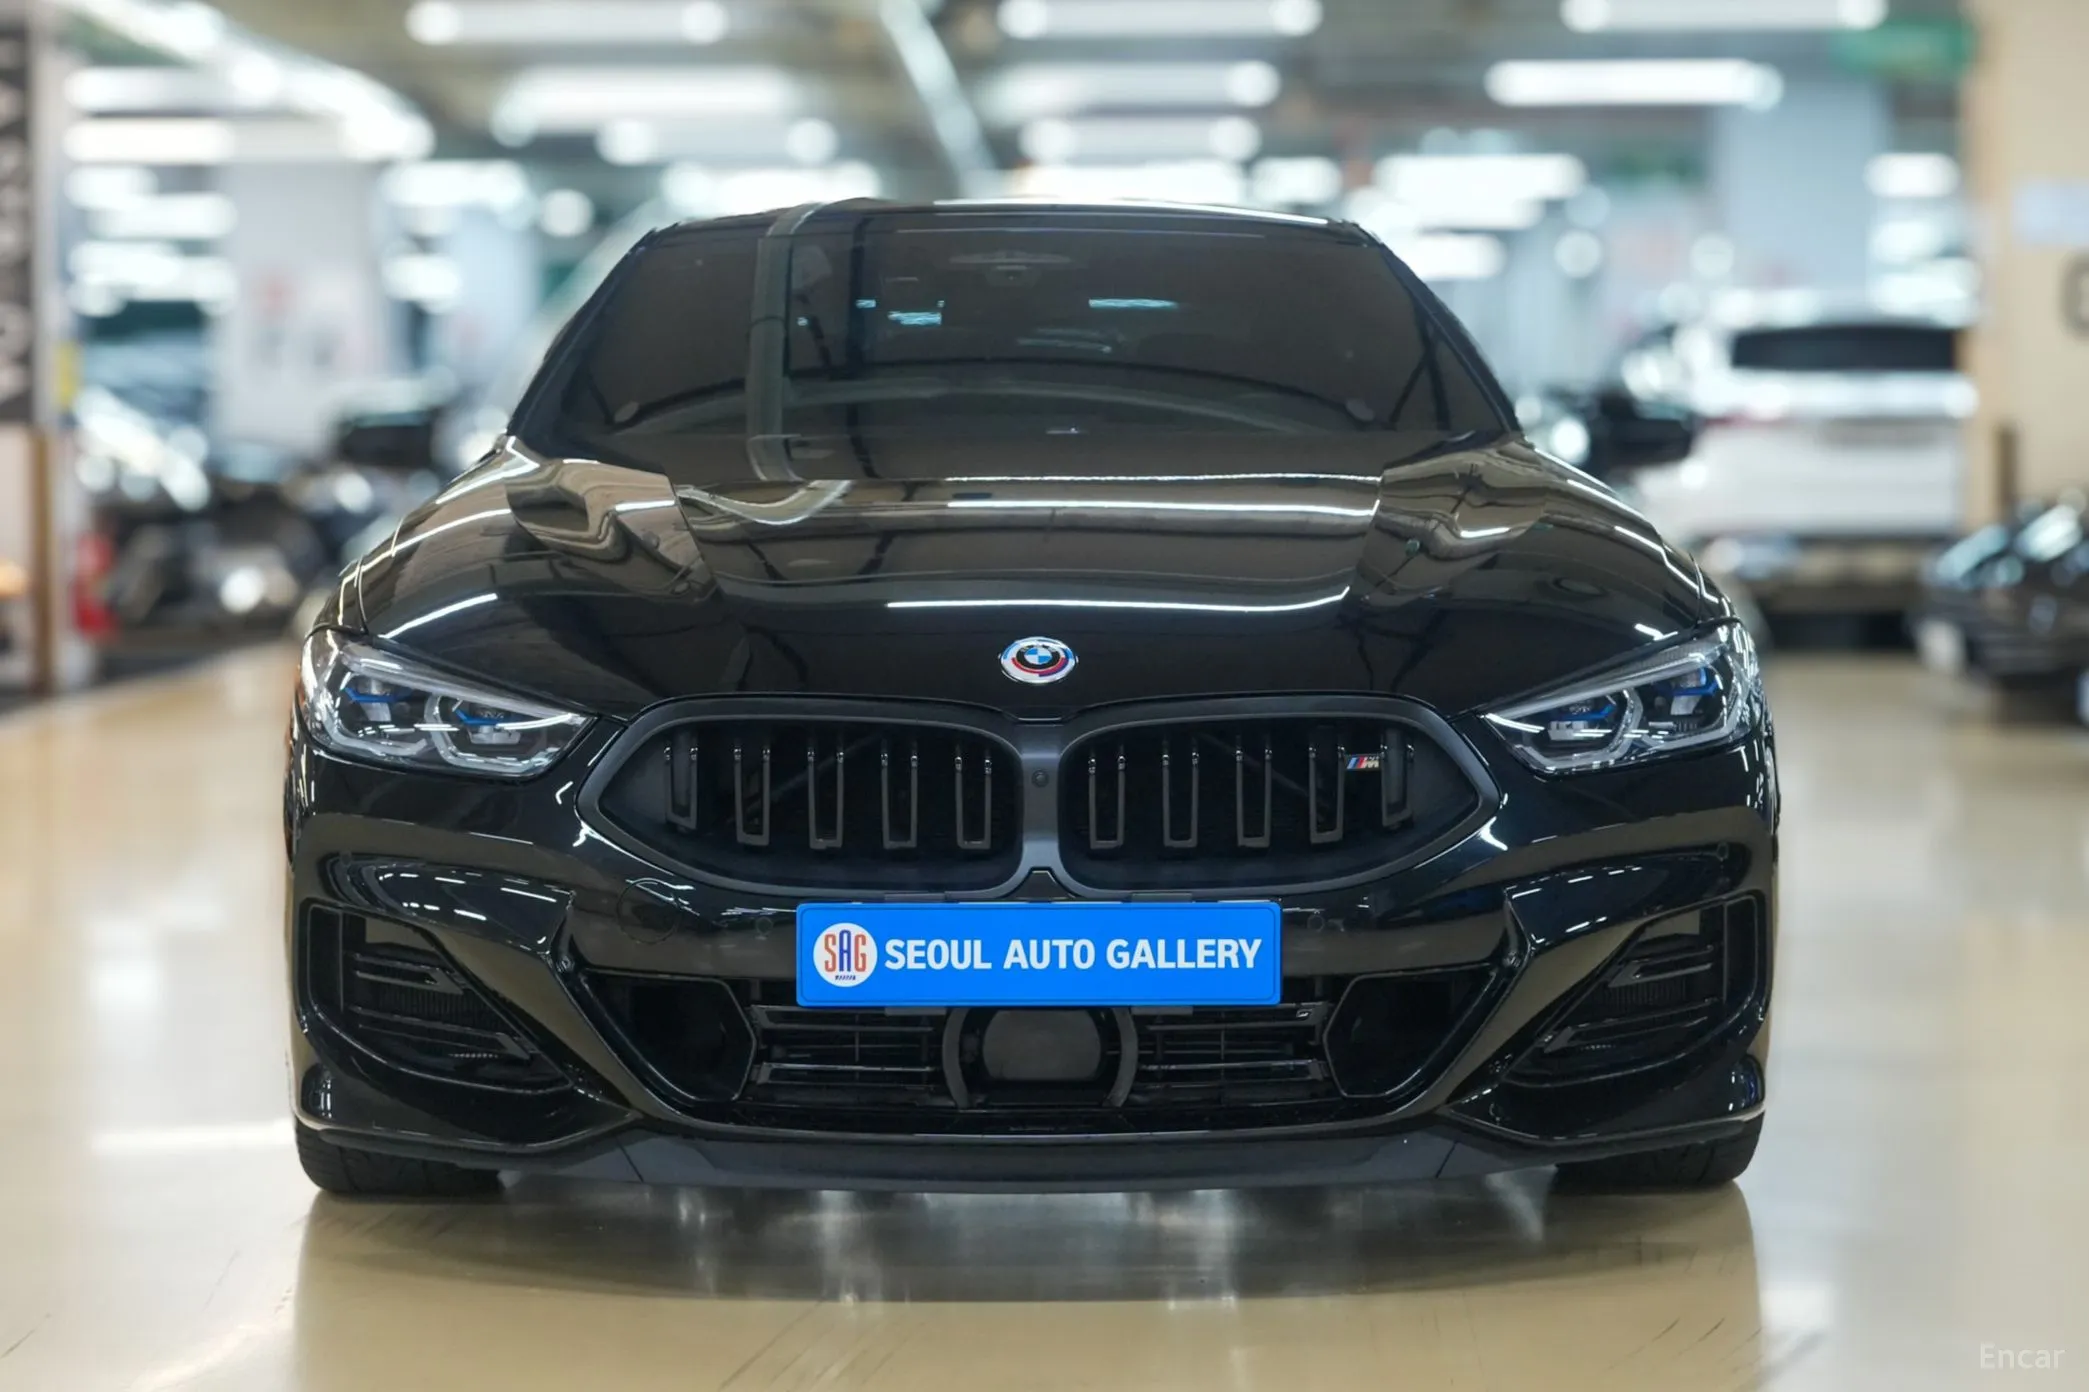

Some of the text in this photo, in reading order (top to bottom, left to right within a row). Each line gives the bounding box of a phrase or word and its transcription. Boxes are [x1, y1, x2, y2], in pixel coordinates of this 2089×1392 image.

[824, 929, 867, 972] SAG
[884, 938, 1262, 970] SEOUL AUTO GALLERY
